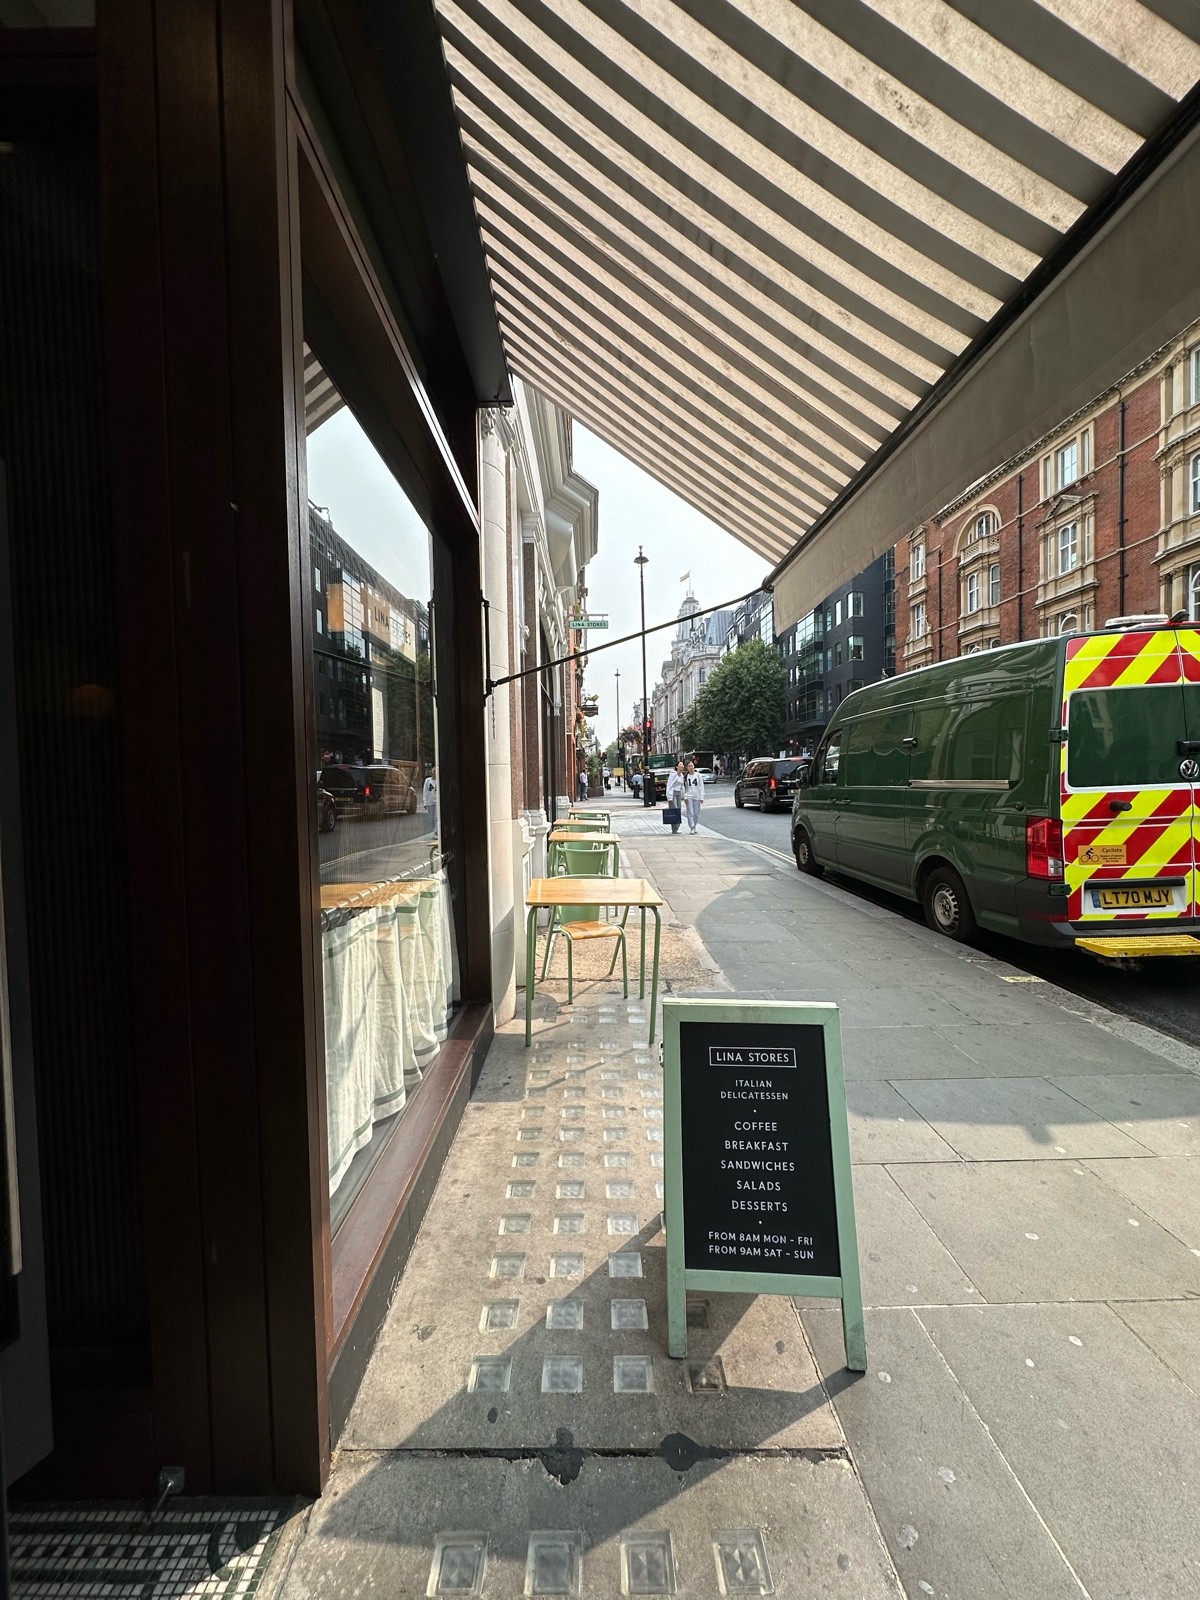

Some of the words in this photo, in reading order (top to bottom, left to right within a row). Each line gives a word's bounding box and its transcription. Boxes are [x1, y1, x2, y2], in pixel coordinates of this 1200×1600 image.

[688, 778, 698, 787] 14
[1102, 890, 1140, 905] LT70
[1143, 889, 1170, 904] MJY
[717, 1052, 742, 1061] LINA
[749, 1053, 789, 1062] STORES
[721, 1091, 788, 1100] DELICATESSEN
[735, 1122, 777, 1131] COFFEE
[725, 1140, 788, 1151] BREAKFAST
[721, 1160, 794, 1171] SANDWICHES
[737, 1180, 780, 1191] SALADS
[732, 1200, 787, 1211] DESSERTS
[709, 1232, 736, 1240] FROM
[740, 1233, 760, 1242] 8AM
[764, 1235, 786, 1243] MON
[798, 1237, 812, 1245] FRI
[709, 1245, 736, 1254] FROM
[740, 1247, 760, 1256] 9AM
[764, 1249, 782, 1257] SAT
[794, 1250, 813, 1259] SUN
